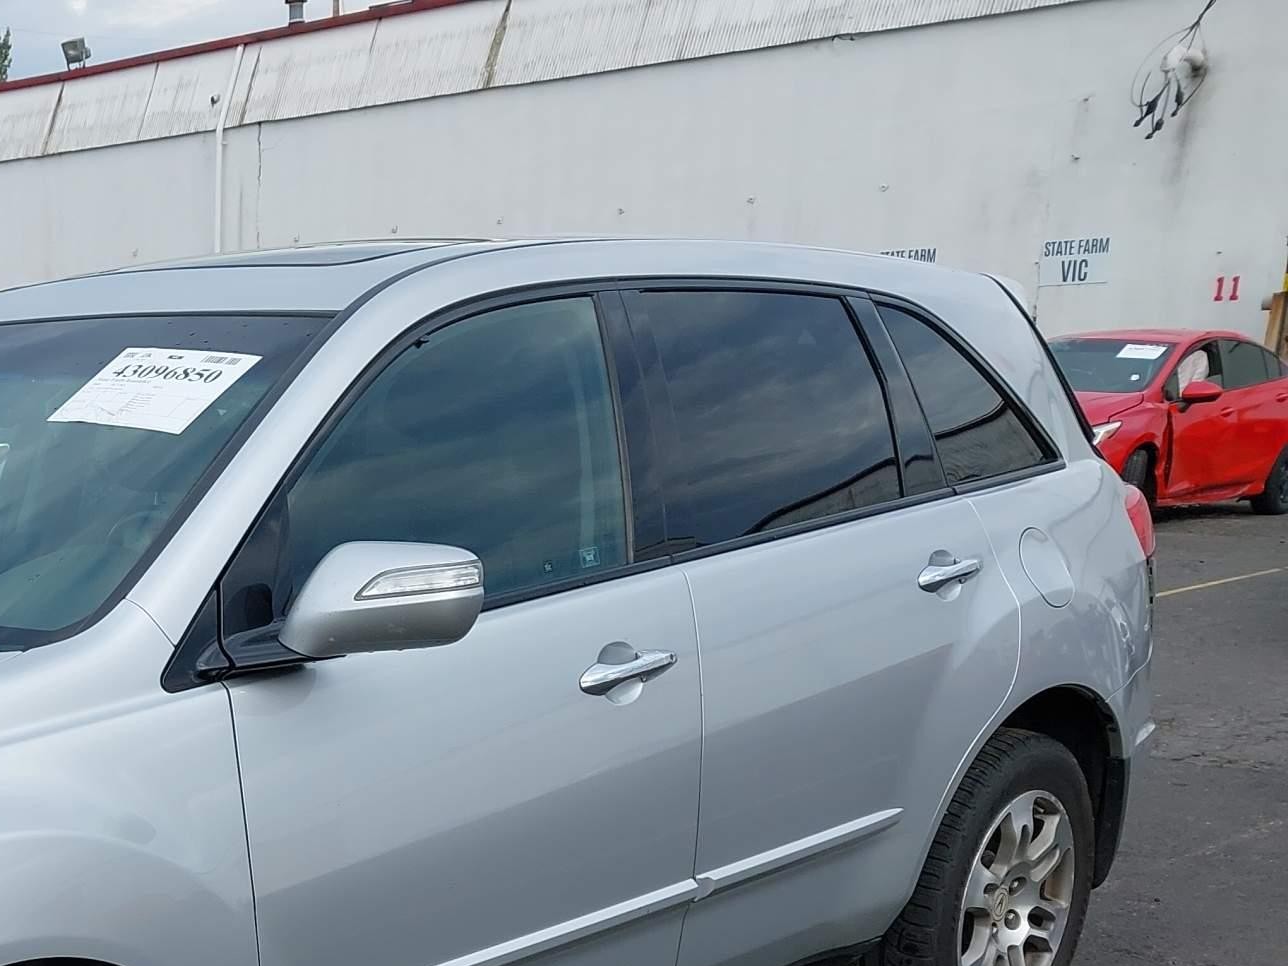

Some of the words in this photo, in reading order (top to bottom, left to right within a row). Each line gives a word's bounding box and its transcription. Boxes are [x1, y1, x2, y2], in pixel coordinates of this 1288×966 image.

[1044, 240, 1075, 257] STATE
[1078, 237, 1110, 255] FARM
[1061, 258, 1088, 282] VIC
[1213, 275, 1241, 302] 11
[112, 364, 223, 384] 43096850
